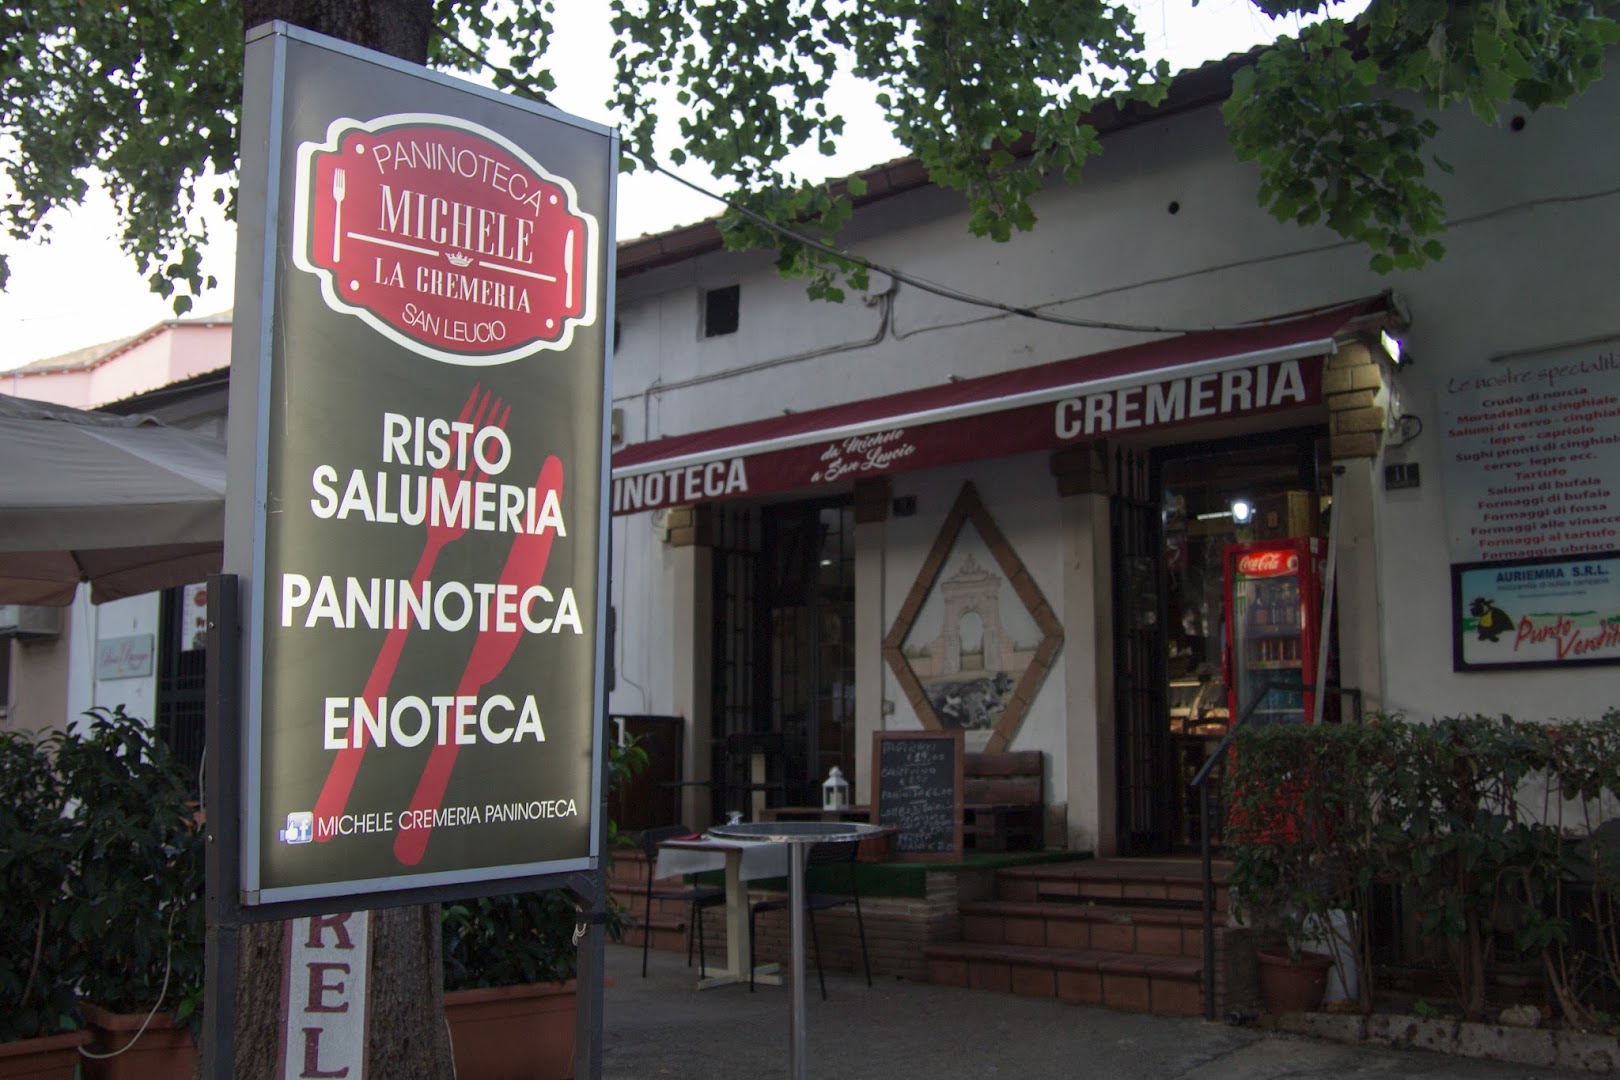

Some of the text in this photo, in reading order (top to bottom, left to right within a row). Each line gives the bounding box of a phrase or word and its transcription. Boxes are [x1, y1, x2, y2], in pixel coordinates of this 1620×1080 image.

[372, 141, 542, 217] PANINOTECA
[378, 184, 534, 264] MICHELE
[374, 257, 532, 314] LA CREMERIA
[402, 303, 507, 343] SAN LEUCIO
[1055, 359, 1306, 440] CREMERIA
[1457, 395, 1617, 424] Mortadella di cinghiale
[1482, 386, 1588, 408] Crudo di norcia
[1448, 424, 1494, 438] Salumi
[1497, 421, 1510, 432] di
[1513, 418, 1552, 430] cervo
[1489, 434, 1525, 446] lepre
[1536, 425, 1595, 441] capriolo
[383, 412, 511, 475] RISTO
[1456, 448, 1494, 463] Sughi
[1497, 443, 1540, 458] pronti
[1542, 440, 1556, 451] di
[810, 472, 823, 483] a
[824, 458, 860, 481] San
[1529, 455, 1566, 468] lepre
[1569, 453, 1597, 462] ecc.
[613, 457, 749, 512] INOTECA
[1514, 467, 1567, 480] Tartufo
[1487, 477, 1601, 496] Salumi di bufala
[310, 464, 567, 537] SALUMERIA
[1477, 489, 1611, 510] Formaggi di bufala
[1483, 503, 1607, 522] Formaggi di fossa
[1471, 522, 1536, 536] Formaggi
[1540, 519, 1565, 530] alle
[1479, 528, 1617, 548] Formaggi al tartufo
[1482, 542, 1615, 561] Formaggio ubriaco
[1497, 565, 1609, 582] AURIEMMA S.R.L.
[281, 573, 584, 634] PANINOTECA
[1515, 615, 1573, 651] Punto
[323, 694, 546, 750] ENOTECA
[318, 811, 393, 837] MICHELE
[398, 805, 481, 831] CREMERIA
[485, 798, 578, 823] PANINOTECA
